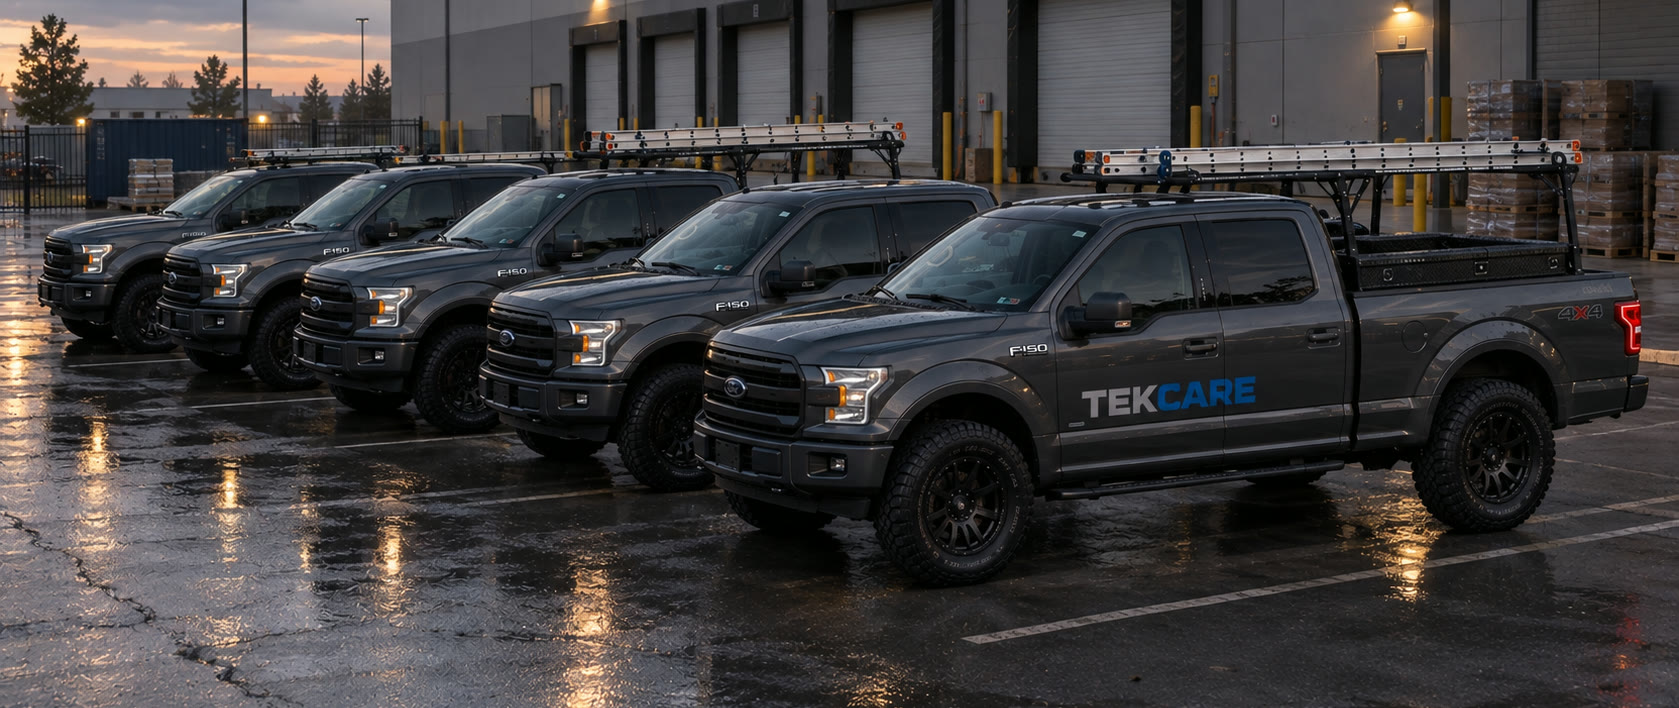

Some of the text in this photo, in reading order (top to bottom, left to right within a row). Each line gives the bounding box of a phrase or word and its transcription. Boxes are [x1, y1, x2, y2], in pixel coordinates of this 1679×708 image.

[715, 300, 750, 312] F-150
[1009, 344, 1048, 357] F-150
[1081, 376, 1256, 418] TEKCARE
